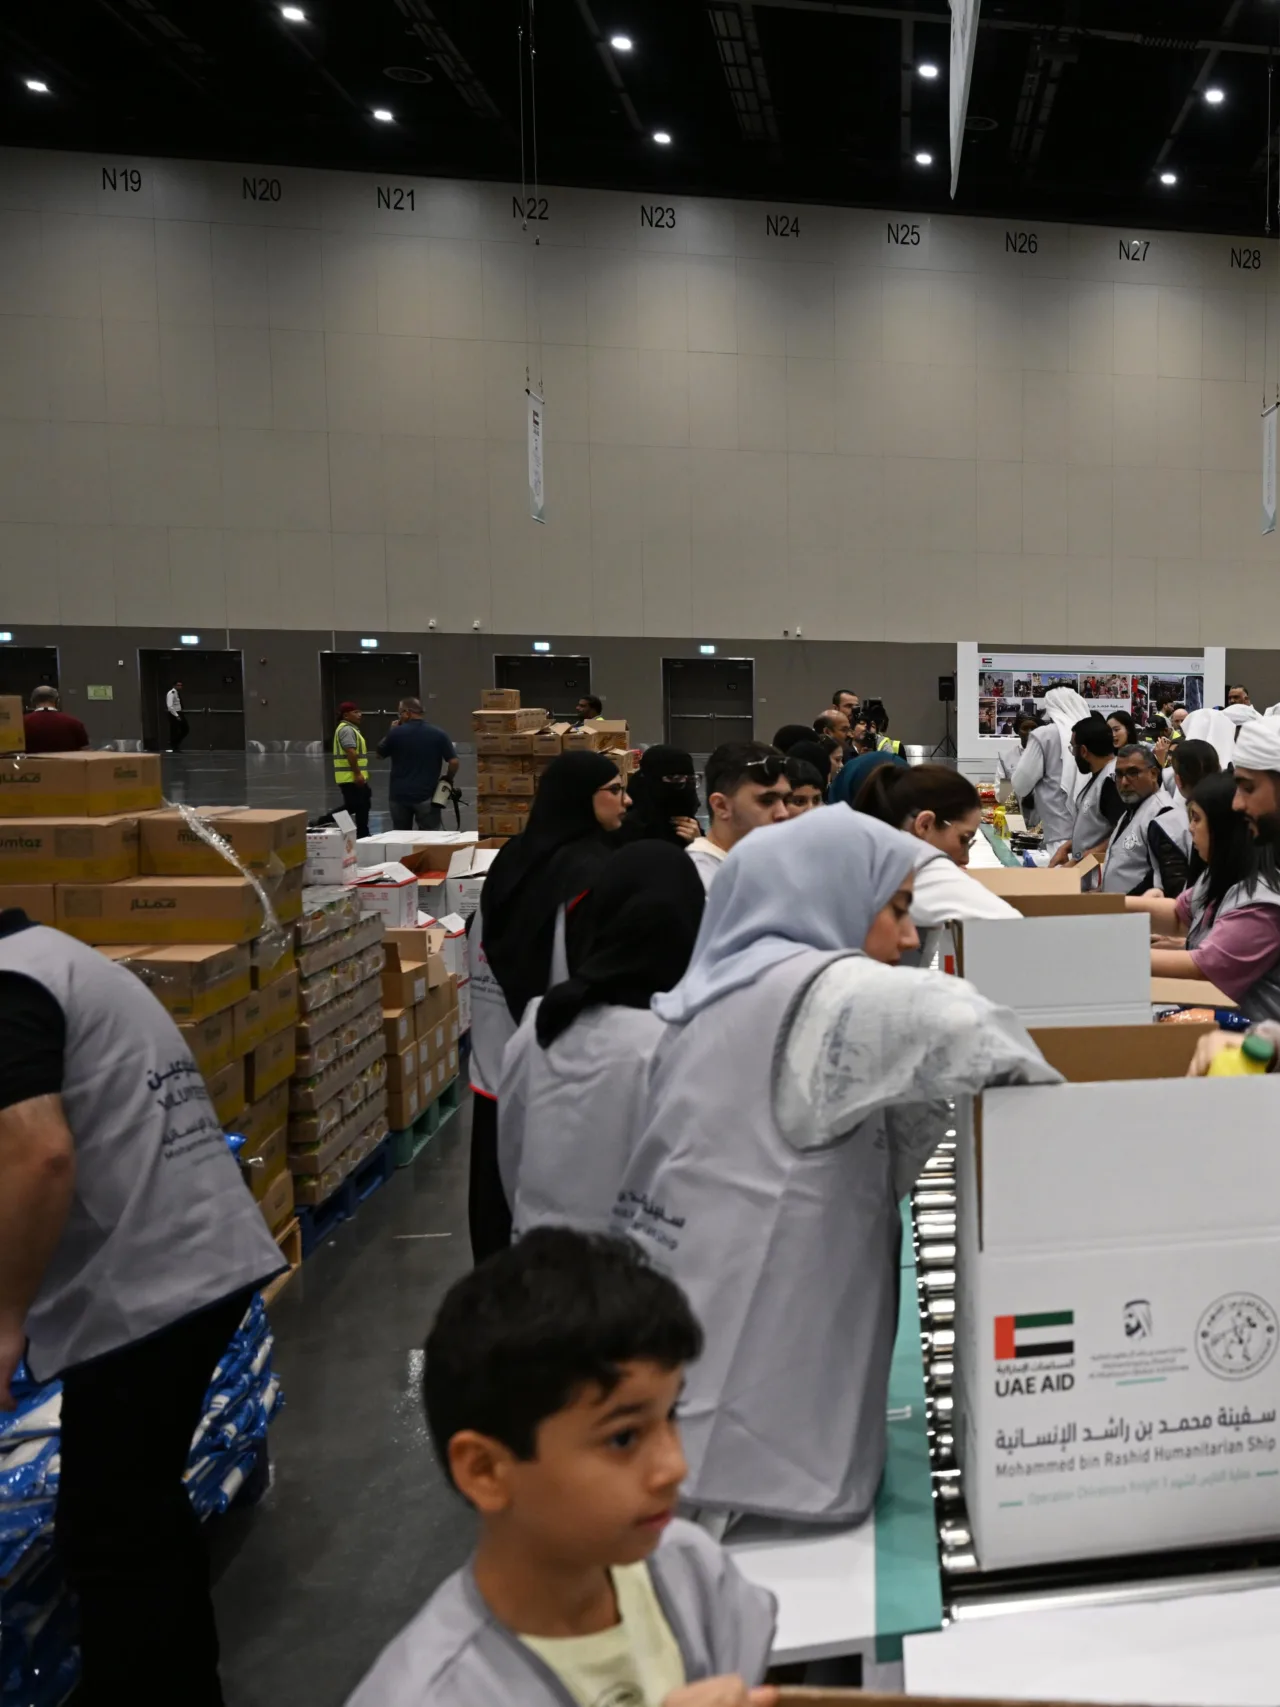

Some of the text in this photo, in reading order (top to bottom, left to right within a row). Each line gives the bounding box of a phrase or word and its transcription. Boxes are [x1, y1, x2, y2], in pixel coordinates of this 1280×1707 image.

[102, 167, 142, 192] N19
[242, 176, 282, 201] N20
[377, 186, 416, 211] N21
[512, 196, 549, 221] N22
[640, 205, 676, 229] N23
[766, 214, 801, 238] N24
[886, 223, 921, 246] N25
[1005, 232, 1038, 254] N26
[1118, 239, 1150, 262] N27
[1231, 248, 1261, 270] N28
[995, 1373, 1075, 1398] UAE AID
[995, 1404, 1277, 1456] سفينة محمد بن راشد الإنسانية
[995, 1434, 1277, 1478] Mohammed bin Rashid Humanitarian Ship
